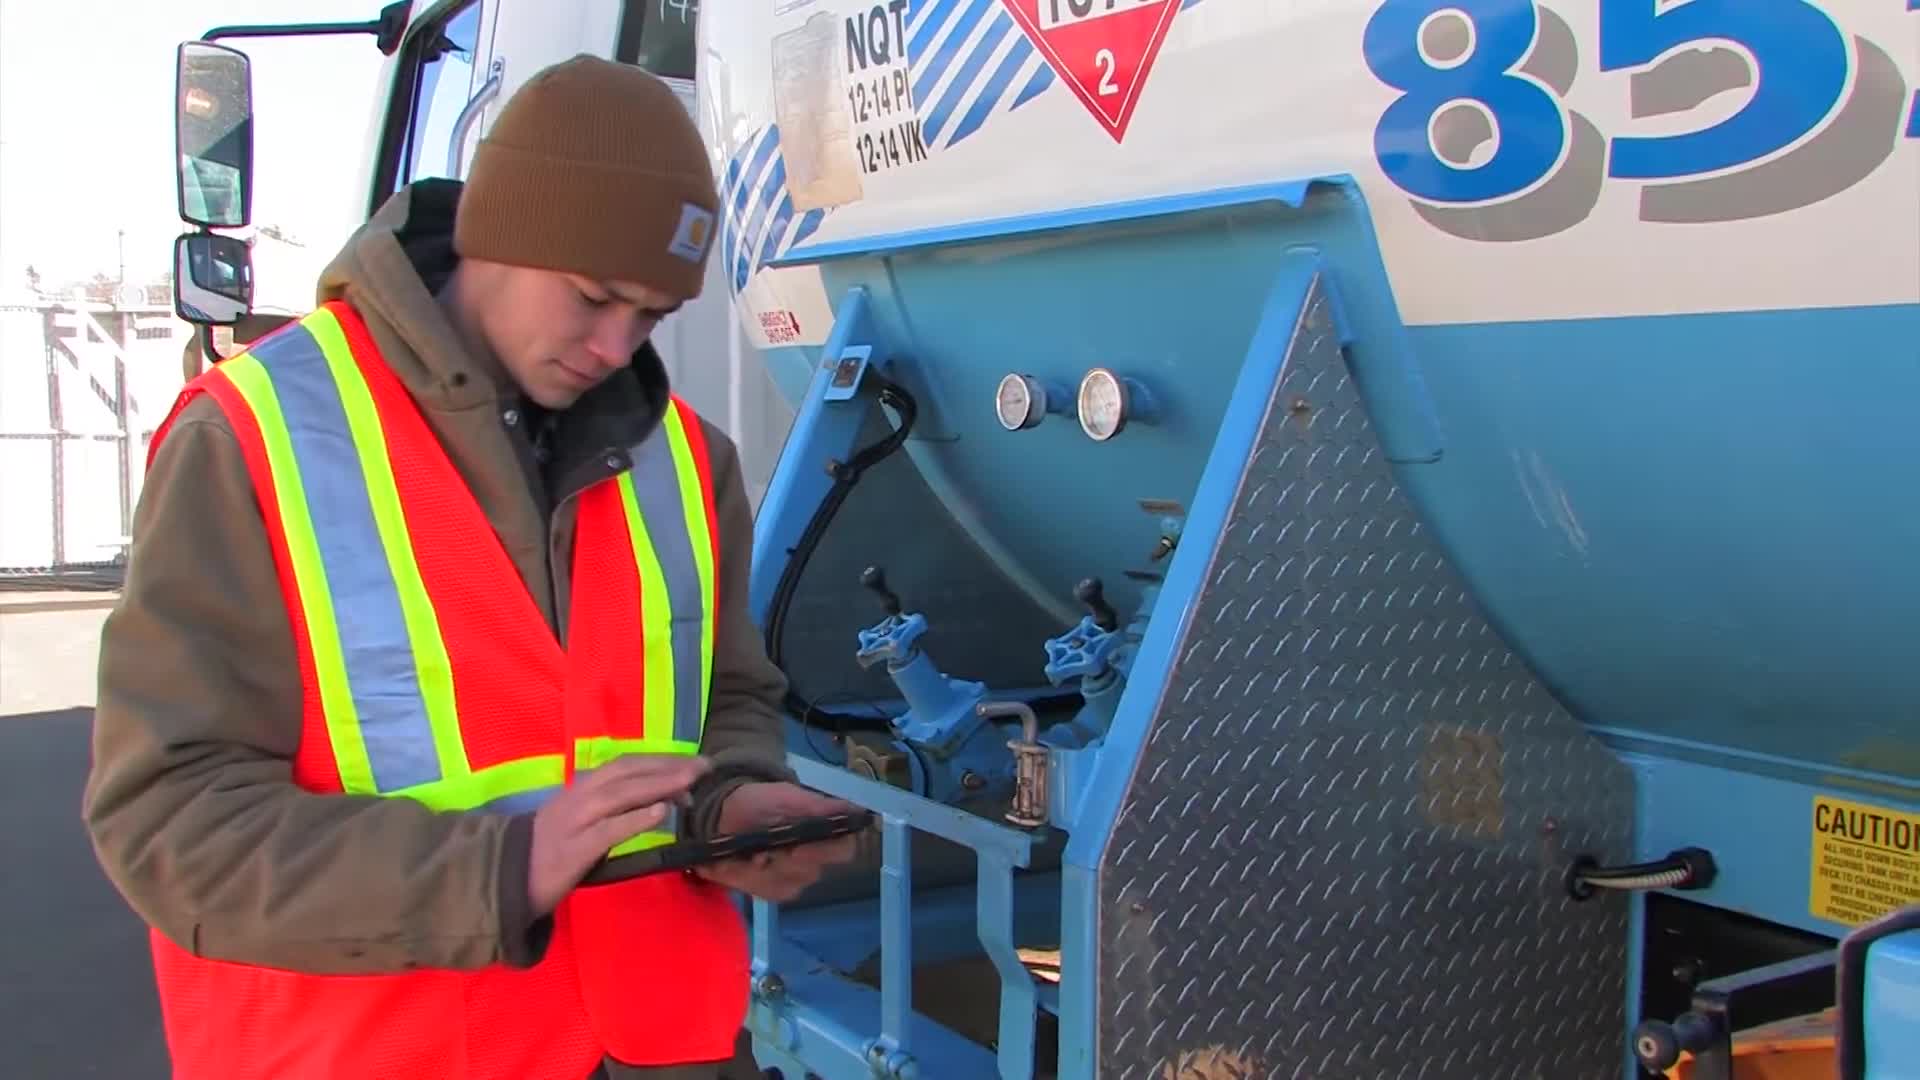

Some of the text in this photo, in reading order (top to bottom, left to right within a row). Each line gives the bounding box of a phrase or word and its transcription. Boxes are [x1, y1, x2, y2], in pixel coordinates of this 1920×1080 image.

[846, 0, 907, 74] NQT
[849, 67, 912, 124] 12-14 PI
[1095, 48, 1119, 96] 2
[1362, 0, 1920, 206] 85
[857, 119, 927, 174] 12-14 VK
